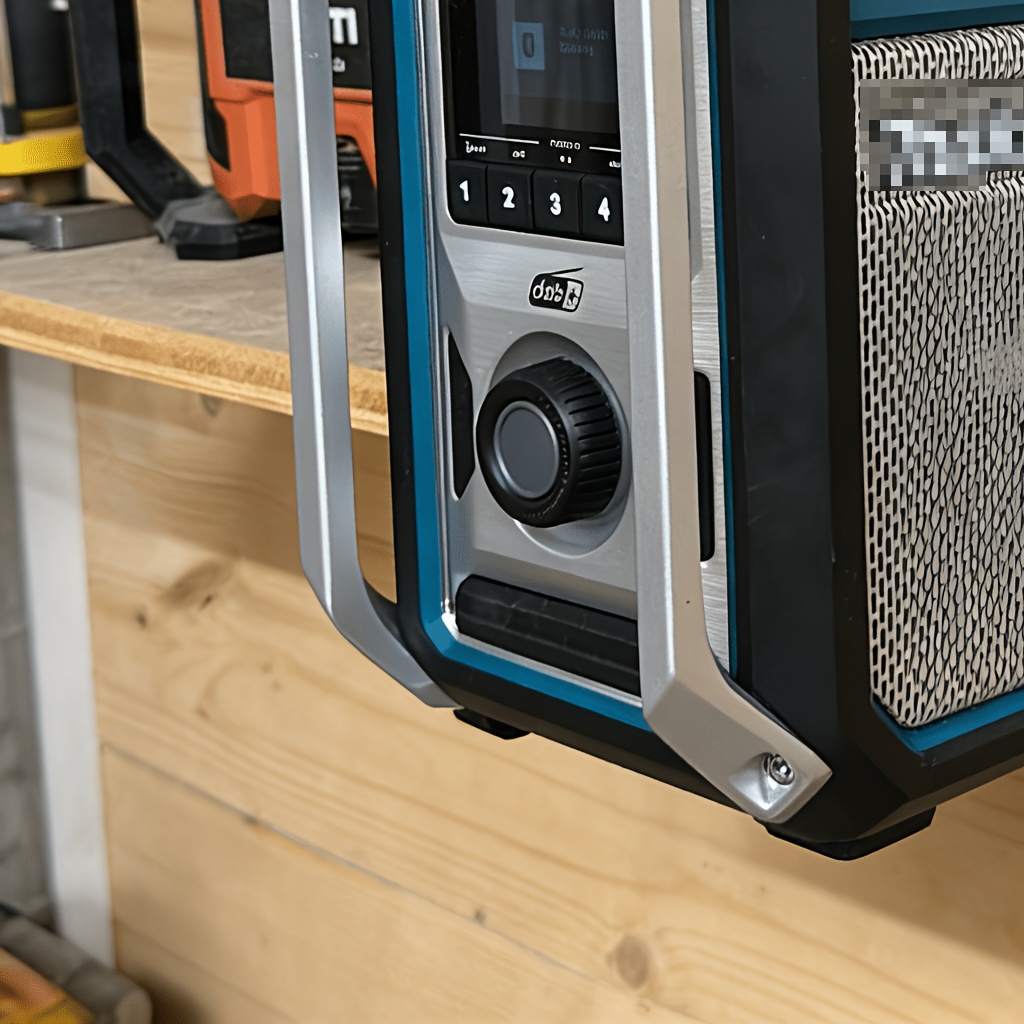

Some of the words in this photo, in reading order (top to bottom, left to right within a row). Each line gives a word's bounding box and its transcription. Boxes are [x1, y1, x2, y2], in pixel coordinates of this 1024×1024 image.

[459, 179, 470, 202] 1
[501, 186, 516, 209] 2
[549, 192, 562, 216] 3
[597, 196, 611, 222] 4
